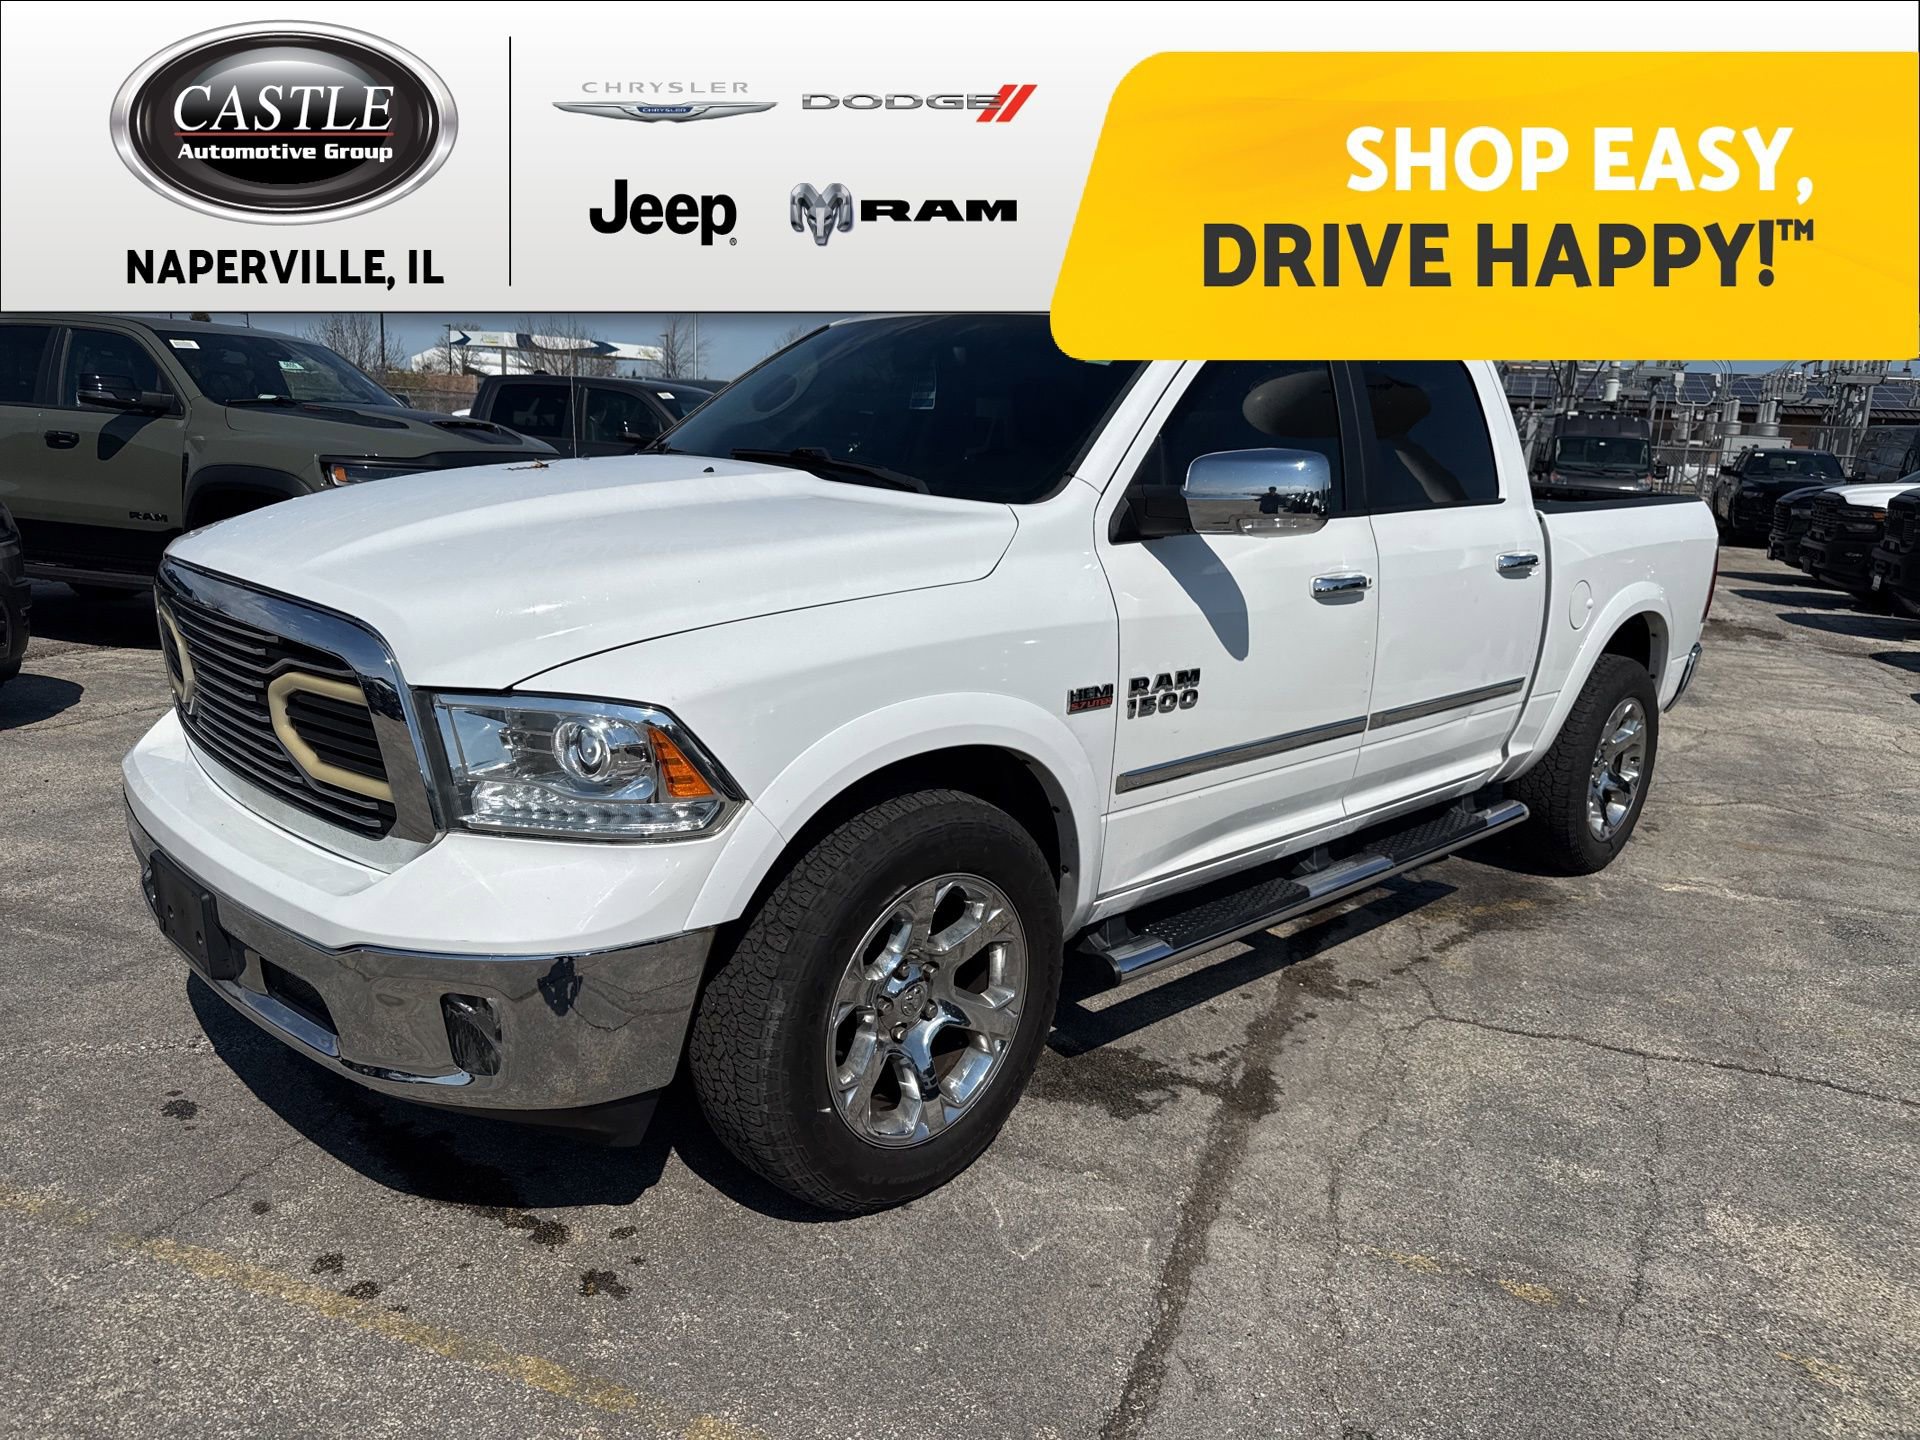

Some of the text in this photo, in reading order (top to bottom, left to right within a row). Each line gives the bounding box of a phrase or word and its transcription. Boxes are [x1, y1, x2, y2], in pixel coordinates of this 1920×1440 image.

[129, 511, 168, 523] RAM
[1067, 683, 1114, 702] HEMI
[1127, 667, 1201, 698] RAM
[1126, 688, 1199, 720] 1500
